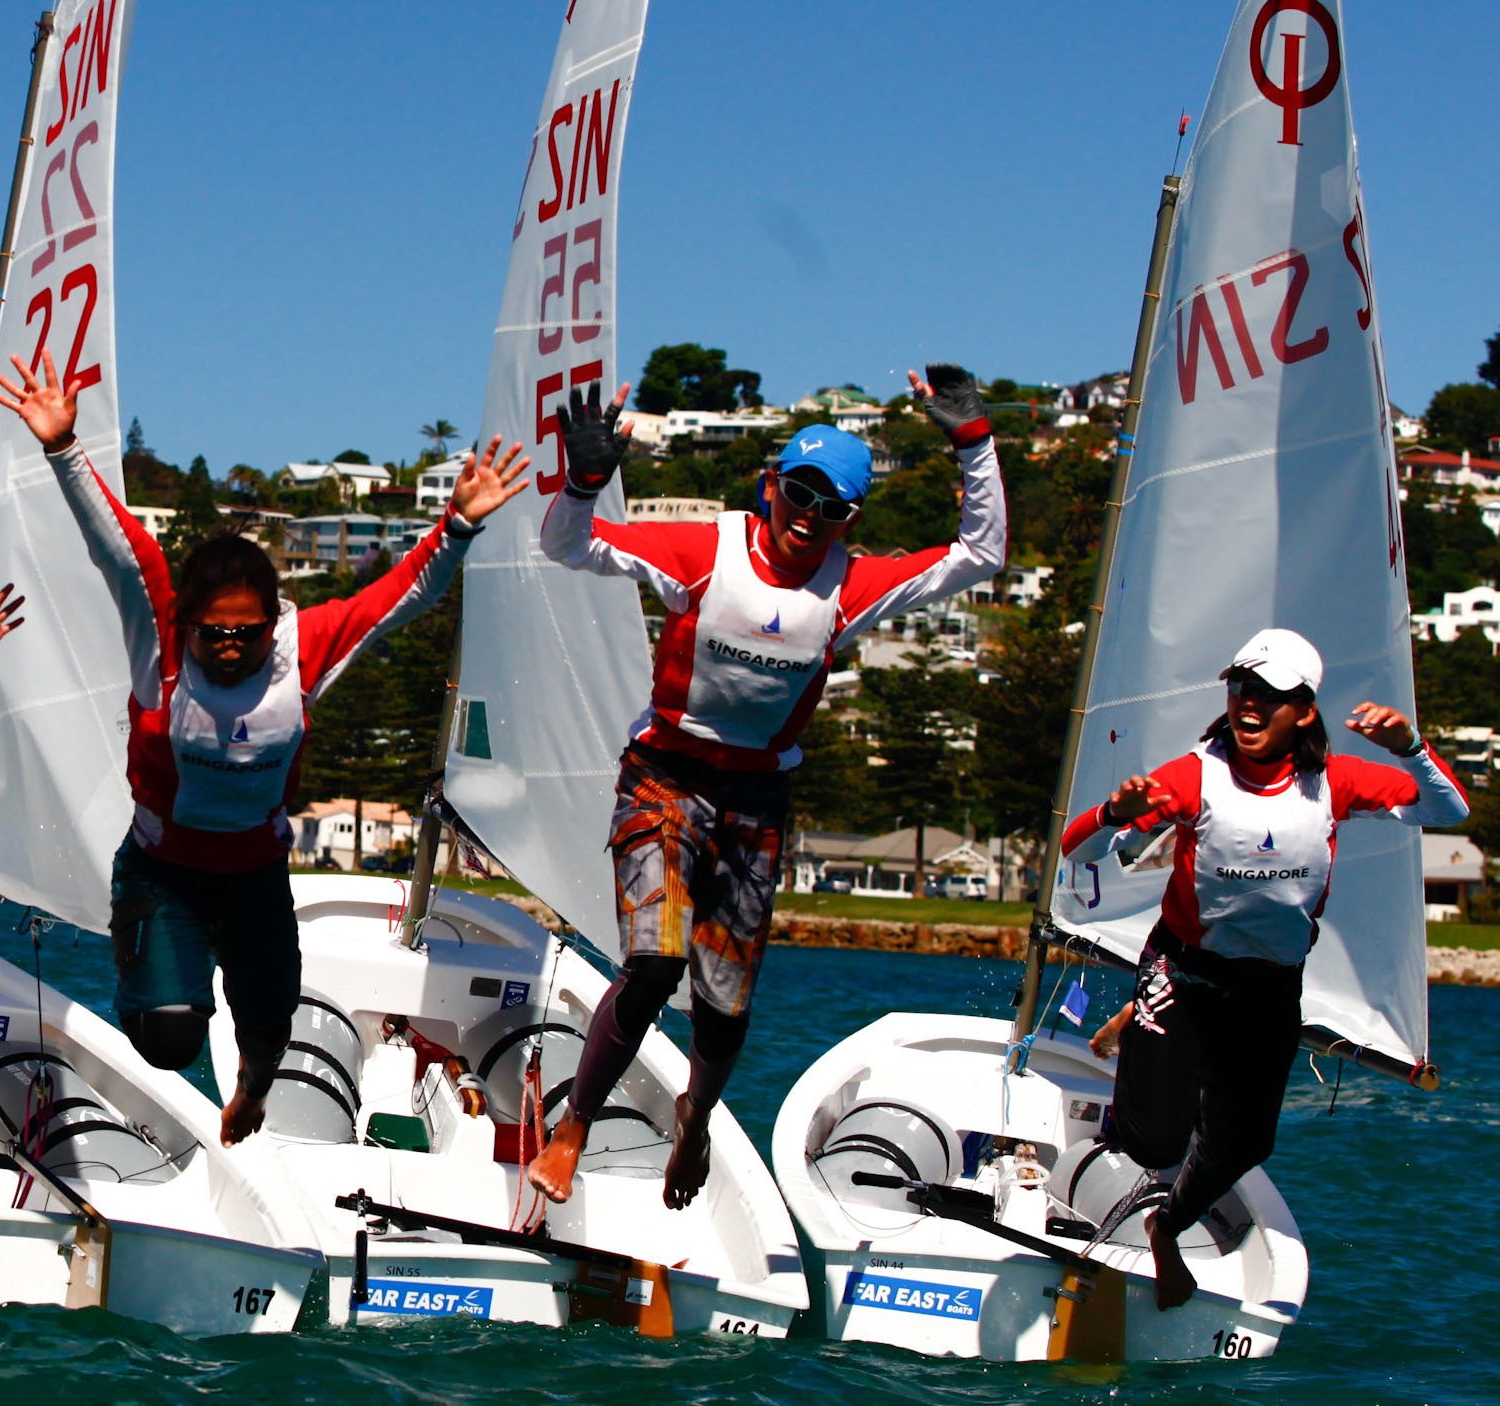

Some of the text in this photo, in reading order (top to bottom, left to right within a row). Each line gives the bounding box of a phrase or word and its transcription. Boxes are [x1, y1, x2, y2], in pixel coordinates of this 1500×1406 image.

[46, 0, 117, 147] SIN
[538, 78, 620, 224] SIN
[707, 639, 813, 673] SINGAPORE
[180, 752, 283, 774] SINGAPORE
[1215, 867, 1309, 881] SINGAPORE
[386, 1265, 404, 1276] SIN
[870, 1258, 904, 1270] SIN 44
[233, 1286, 276, 1315] 167
[403, 1290, 459, 1312] EAST
[852, 1282, 950, 1311] FAR EAST
[946, 1305, 974, 1315] BOATS
[1213, 1329, 1252, 1359] 160
